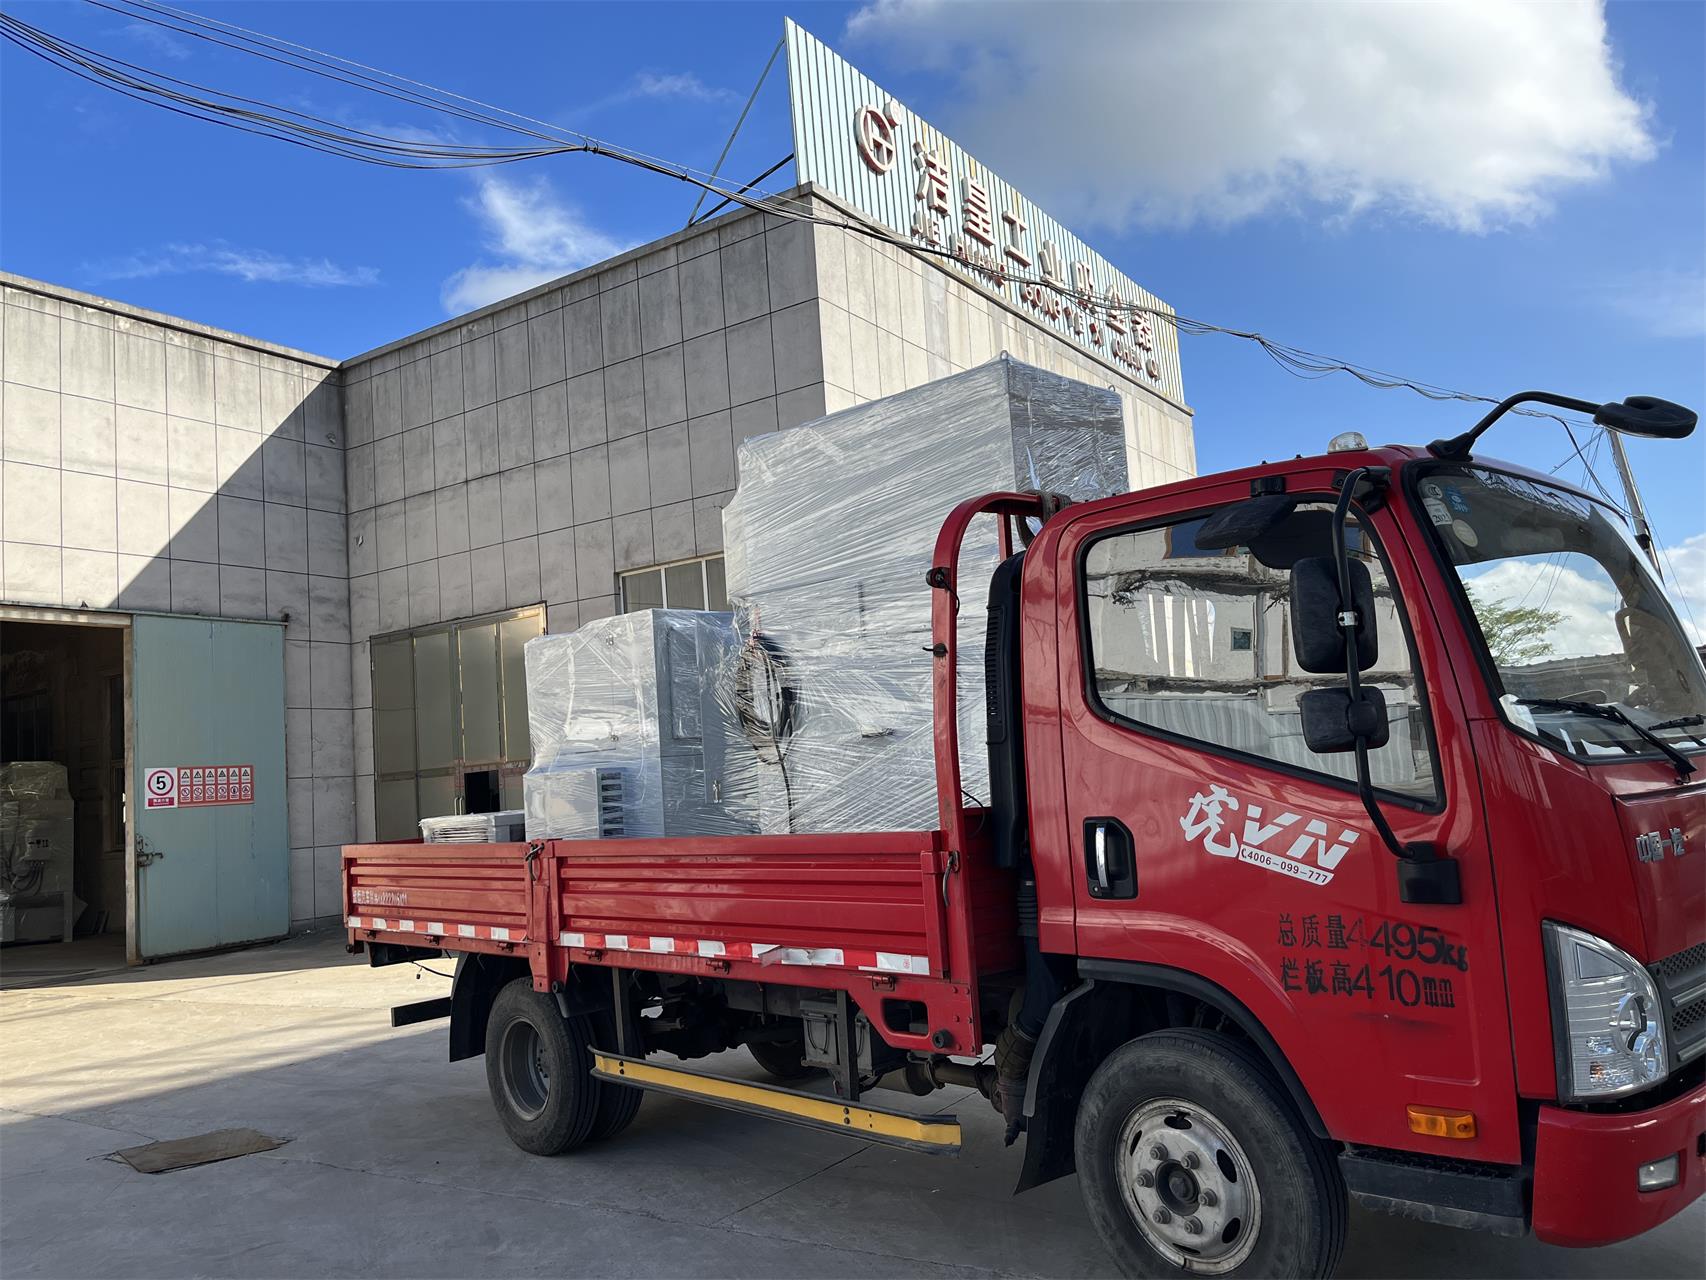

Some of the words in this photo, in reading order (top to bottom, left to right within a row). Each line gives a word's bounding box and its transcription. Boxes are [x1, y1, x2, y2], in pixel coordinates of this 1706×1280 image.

[911, 210, 941, 245] JIE
[156, 775, 167, 790] 5
[1247, 850, 1329, 884] 4006-099-777
